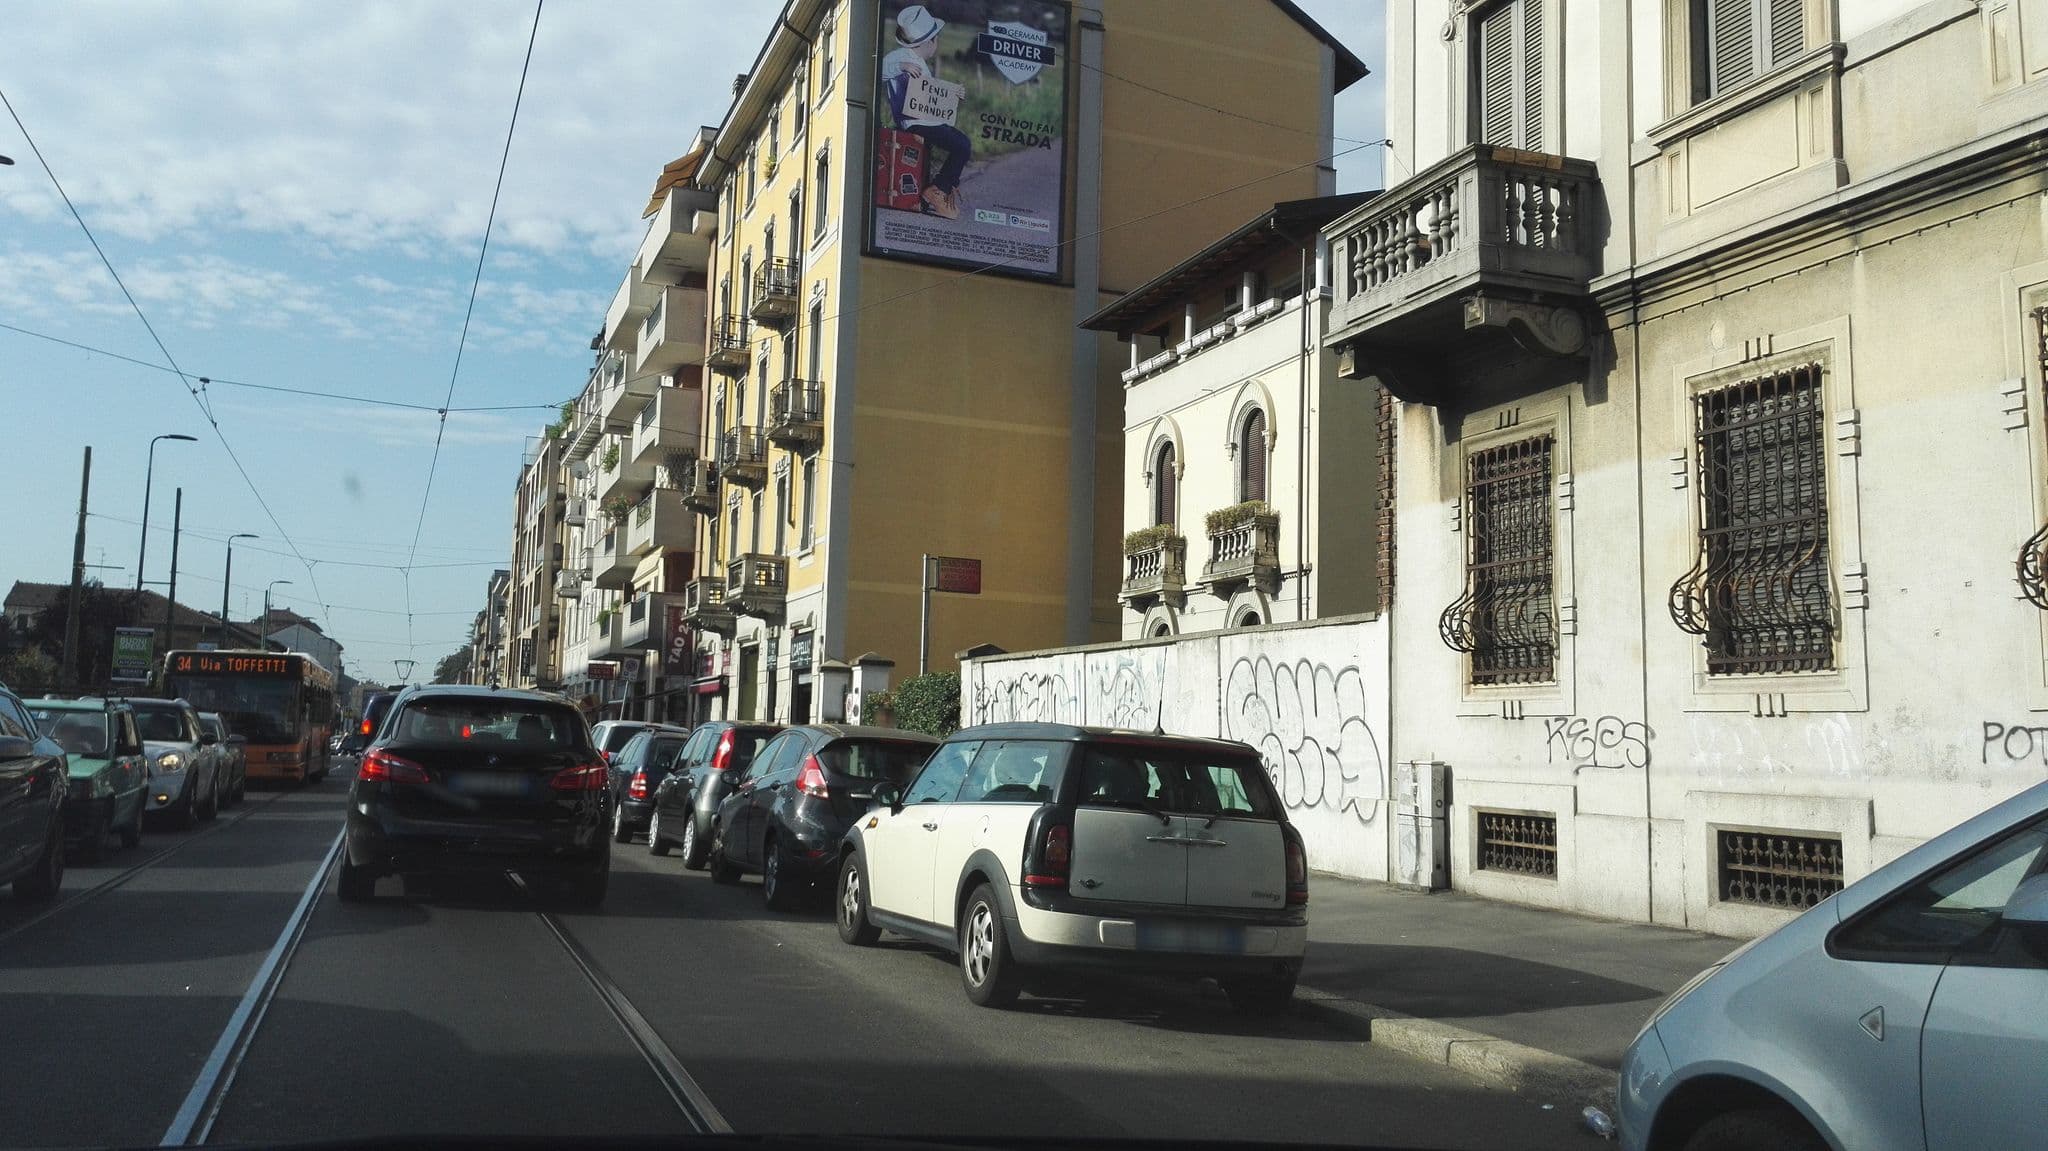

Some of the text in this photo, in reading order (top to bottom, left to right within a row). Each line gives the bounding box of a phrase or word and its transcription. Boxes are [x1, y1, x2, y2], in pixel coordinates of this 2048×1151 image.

[1007, 29, 1044, 42] GERMANI
[993, 39, 1041, 60] DRIVER
[998, 59, 1036, 72] ACADEMY
[921, 79, 949, 98] PENSI
[909, 97, 954, 120] GRANDE?
[928, 95, 938, 106] IN
[980, 113, 1054, 135] CON NOI FAI
[981, 125, 1052, 150] STRADA
[668, 636, 685, 664] TAO
[177, 656, 288, 672] 34 Via TOFFETTI
